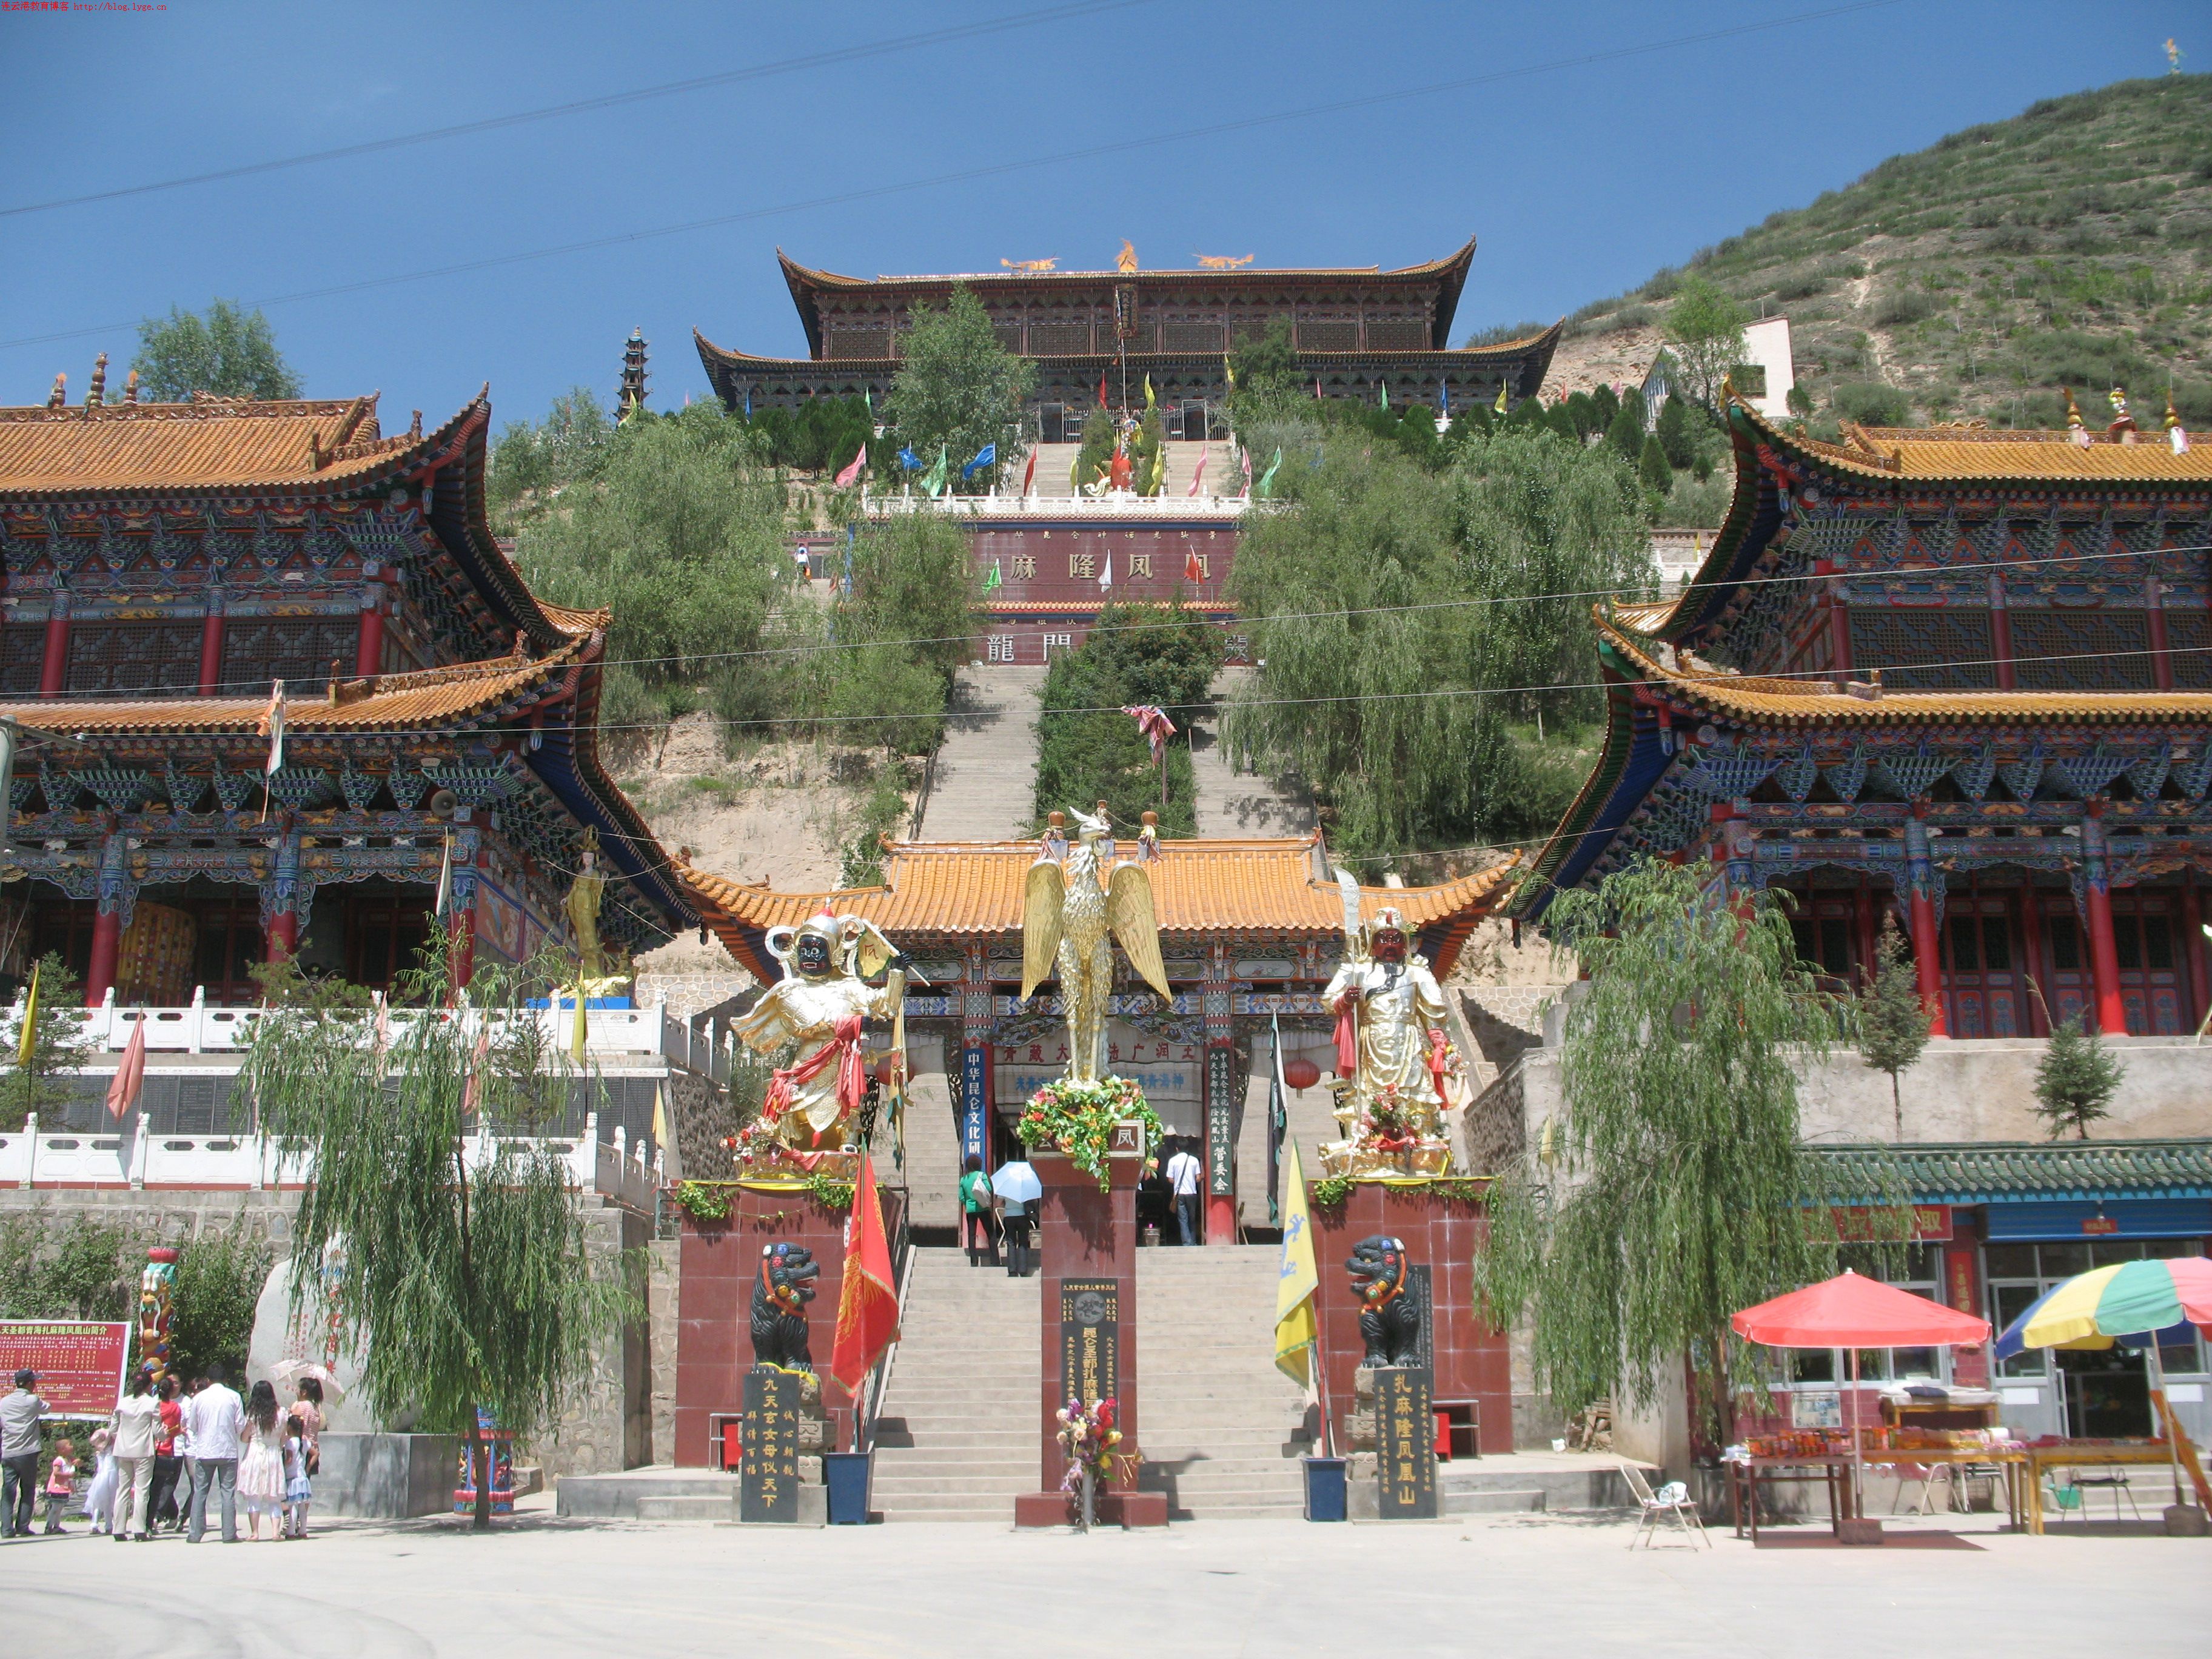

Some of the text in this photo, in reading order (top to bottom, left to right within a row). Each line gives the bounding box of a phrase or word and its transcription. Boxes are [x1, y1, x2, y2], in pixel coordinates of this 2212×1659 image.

[987, 634, 1071, 662] 龍門
[968, 1053, 980, 1154] 中华昆仑文化研
[1116, 1129, 1135, 1147] 凤
[1213, 1146, 1229, 1191] 管委会
[0, 1326, 107, 1335] 天圣都青海扎麻隆凤凰山简介
[762, 1379, 779, 1508] 九天玄女母仪天下
[1393, 1374, 1416, 1504] 扎麻隆凤凰山
